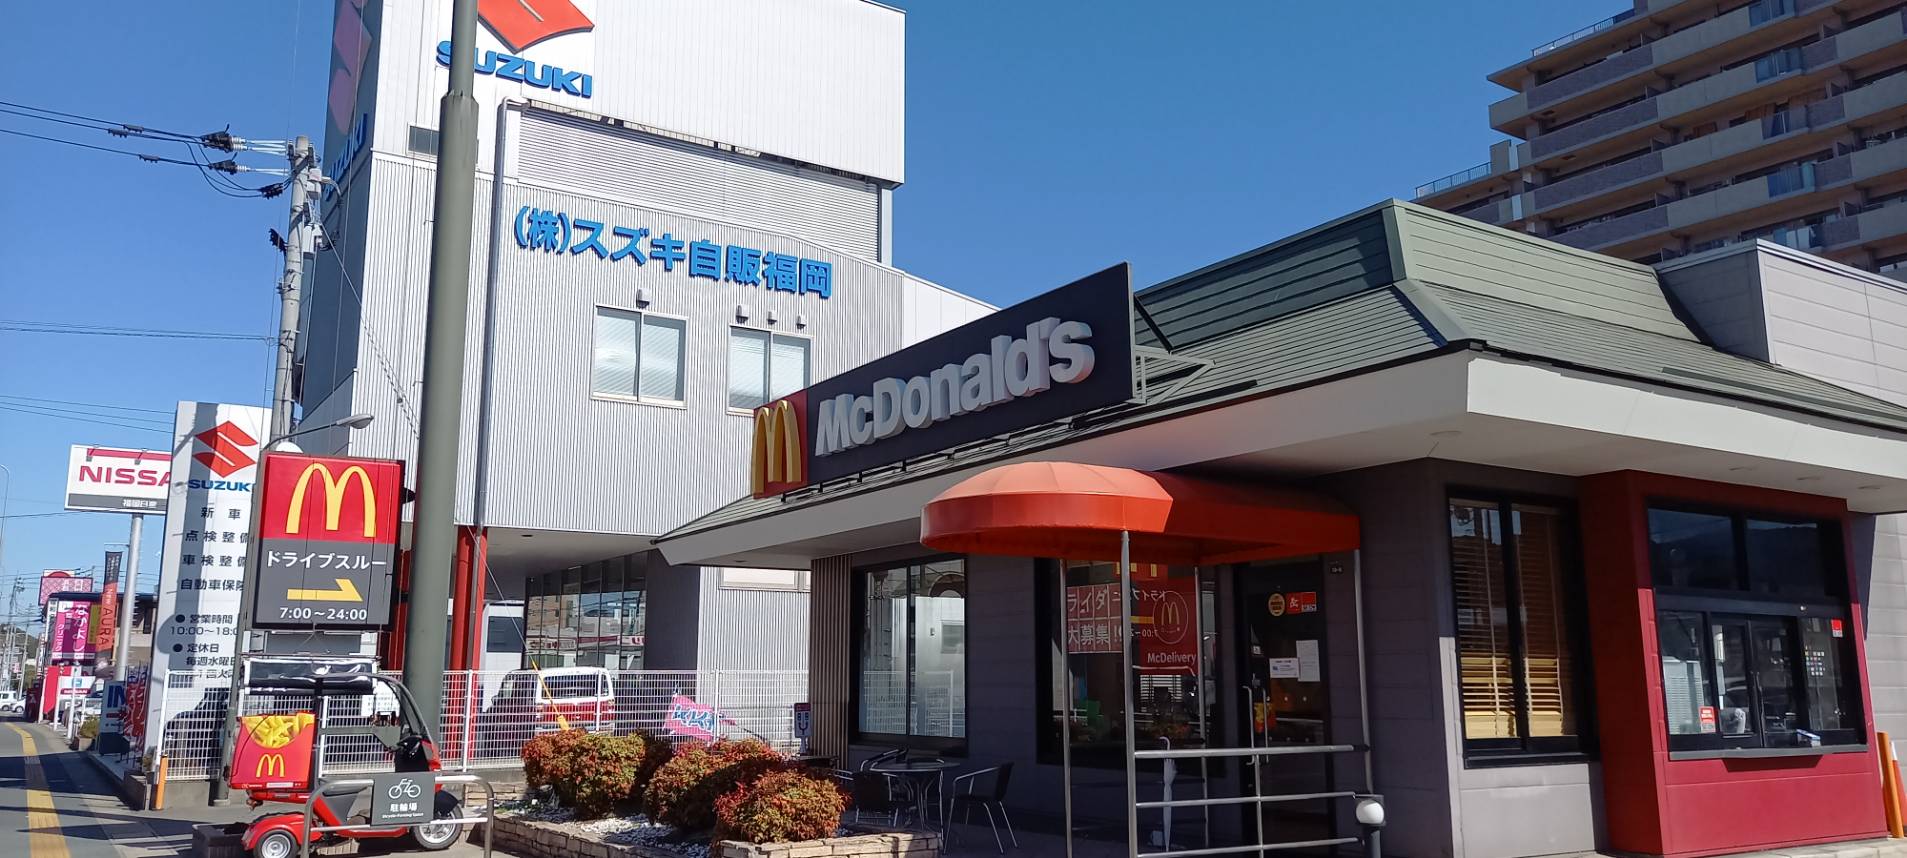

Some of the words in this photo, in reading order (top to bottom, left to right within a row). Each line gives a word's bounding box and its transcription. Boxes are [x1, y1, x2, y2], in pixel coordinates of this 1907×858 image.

[815, 317, 1095, 456] McDonald's
[79, 465, 171, 487] NISSA
[188, 480, 251, 492] SUZUK
[267, 550, 387, 569] ドライブスルー
[190, 614, 233, 624] 営業時間
[186, 643, 220, 653] 定休日
[1147, 651, 1197, 664] McDelivery
